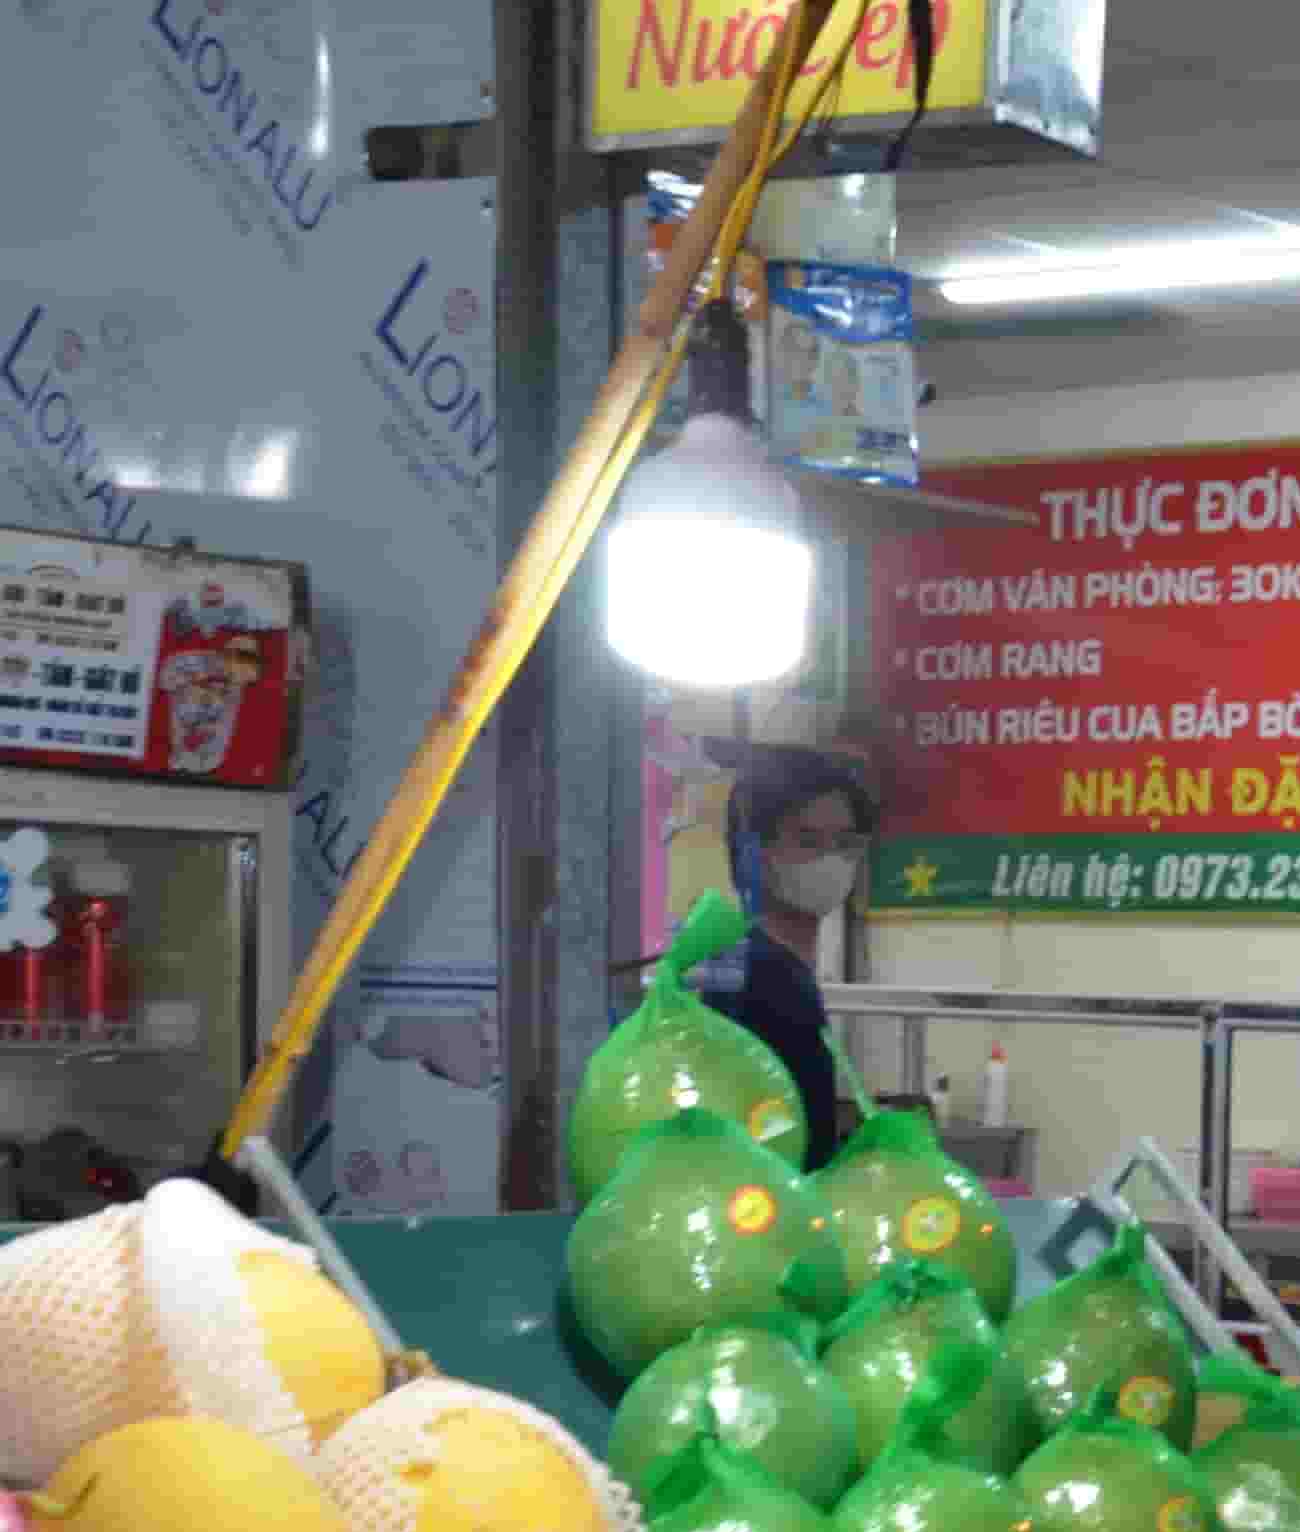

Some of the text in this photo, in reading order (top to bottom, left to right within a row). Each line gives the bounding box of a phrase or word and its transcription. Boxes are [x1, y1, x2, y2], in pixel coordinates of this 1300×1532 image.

[1040, 478, 1184, 550] THỰC
[918, 577, 994, 616] CƠM
[914, 639, 1103, 681] CƠM RANG
[915, 702, 989, 746] BÚN
[997, 697, 1080, 745] RIÊU
[1088, 703, 1161, 743] CUA
[1062, 755, 1211, 831] NHẬN
[990, 854, 1074, 897] Liên
